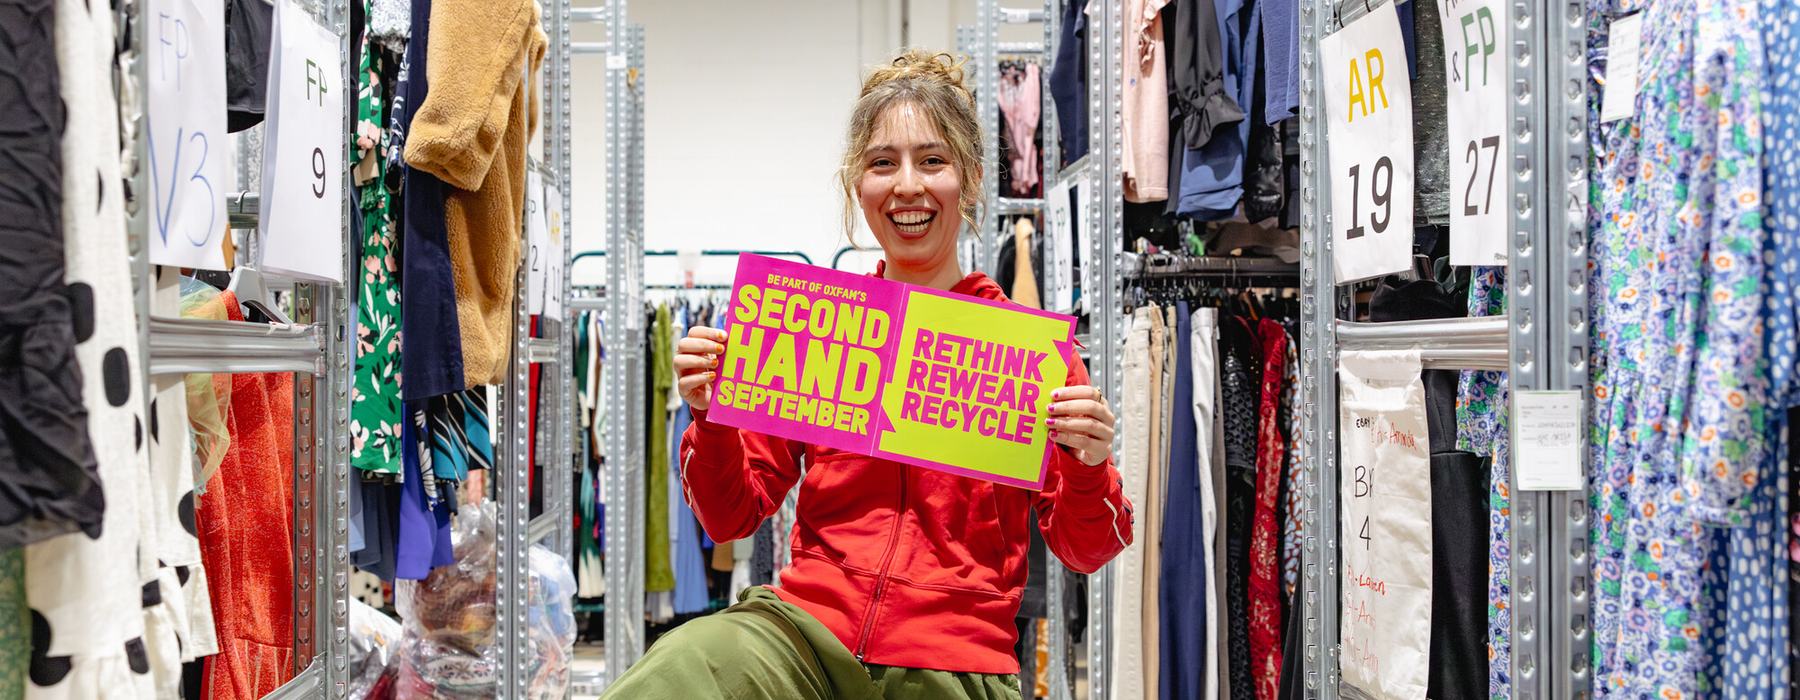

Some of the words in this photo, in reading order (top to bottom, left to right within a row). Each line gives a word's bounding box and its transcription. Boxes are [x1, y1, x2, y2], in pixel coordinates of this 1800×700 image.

[159, 12, 190, 92] FP
[1460, 6, 1496, 92] FP
[306, 58, 328, 107] FP
[1347, 47, 1389, 123] AR
[312, 147, 326, 199] 9
[1346, 156, 1393, 240] 19
[1463, 135, 1500, 217] 27
[735, 284, 891, 349] SECOND
[767, 274, 780, 285] BE
[782, 277, 808, 290] PART
[809, 282, 823, 293] OF
[824, 285, 867, 302] OXFAM'S
[721, 322, 882, 406] HAND
[912, 328, 1048, 382] RETHINK
[717, 379, 870, 436] SEPTEMBER
[907, 359, 1041, 414] REWEAR
[901, 391, 1035, 446] RECYCLE
[1359, 515, 1372, 551] 4
